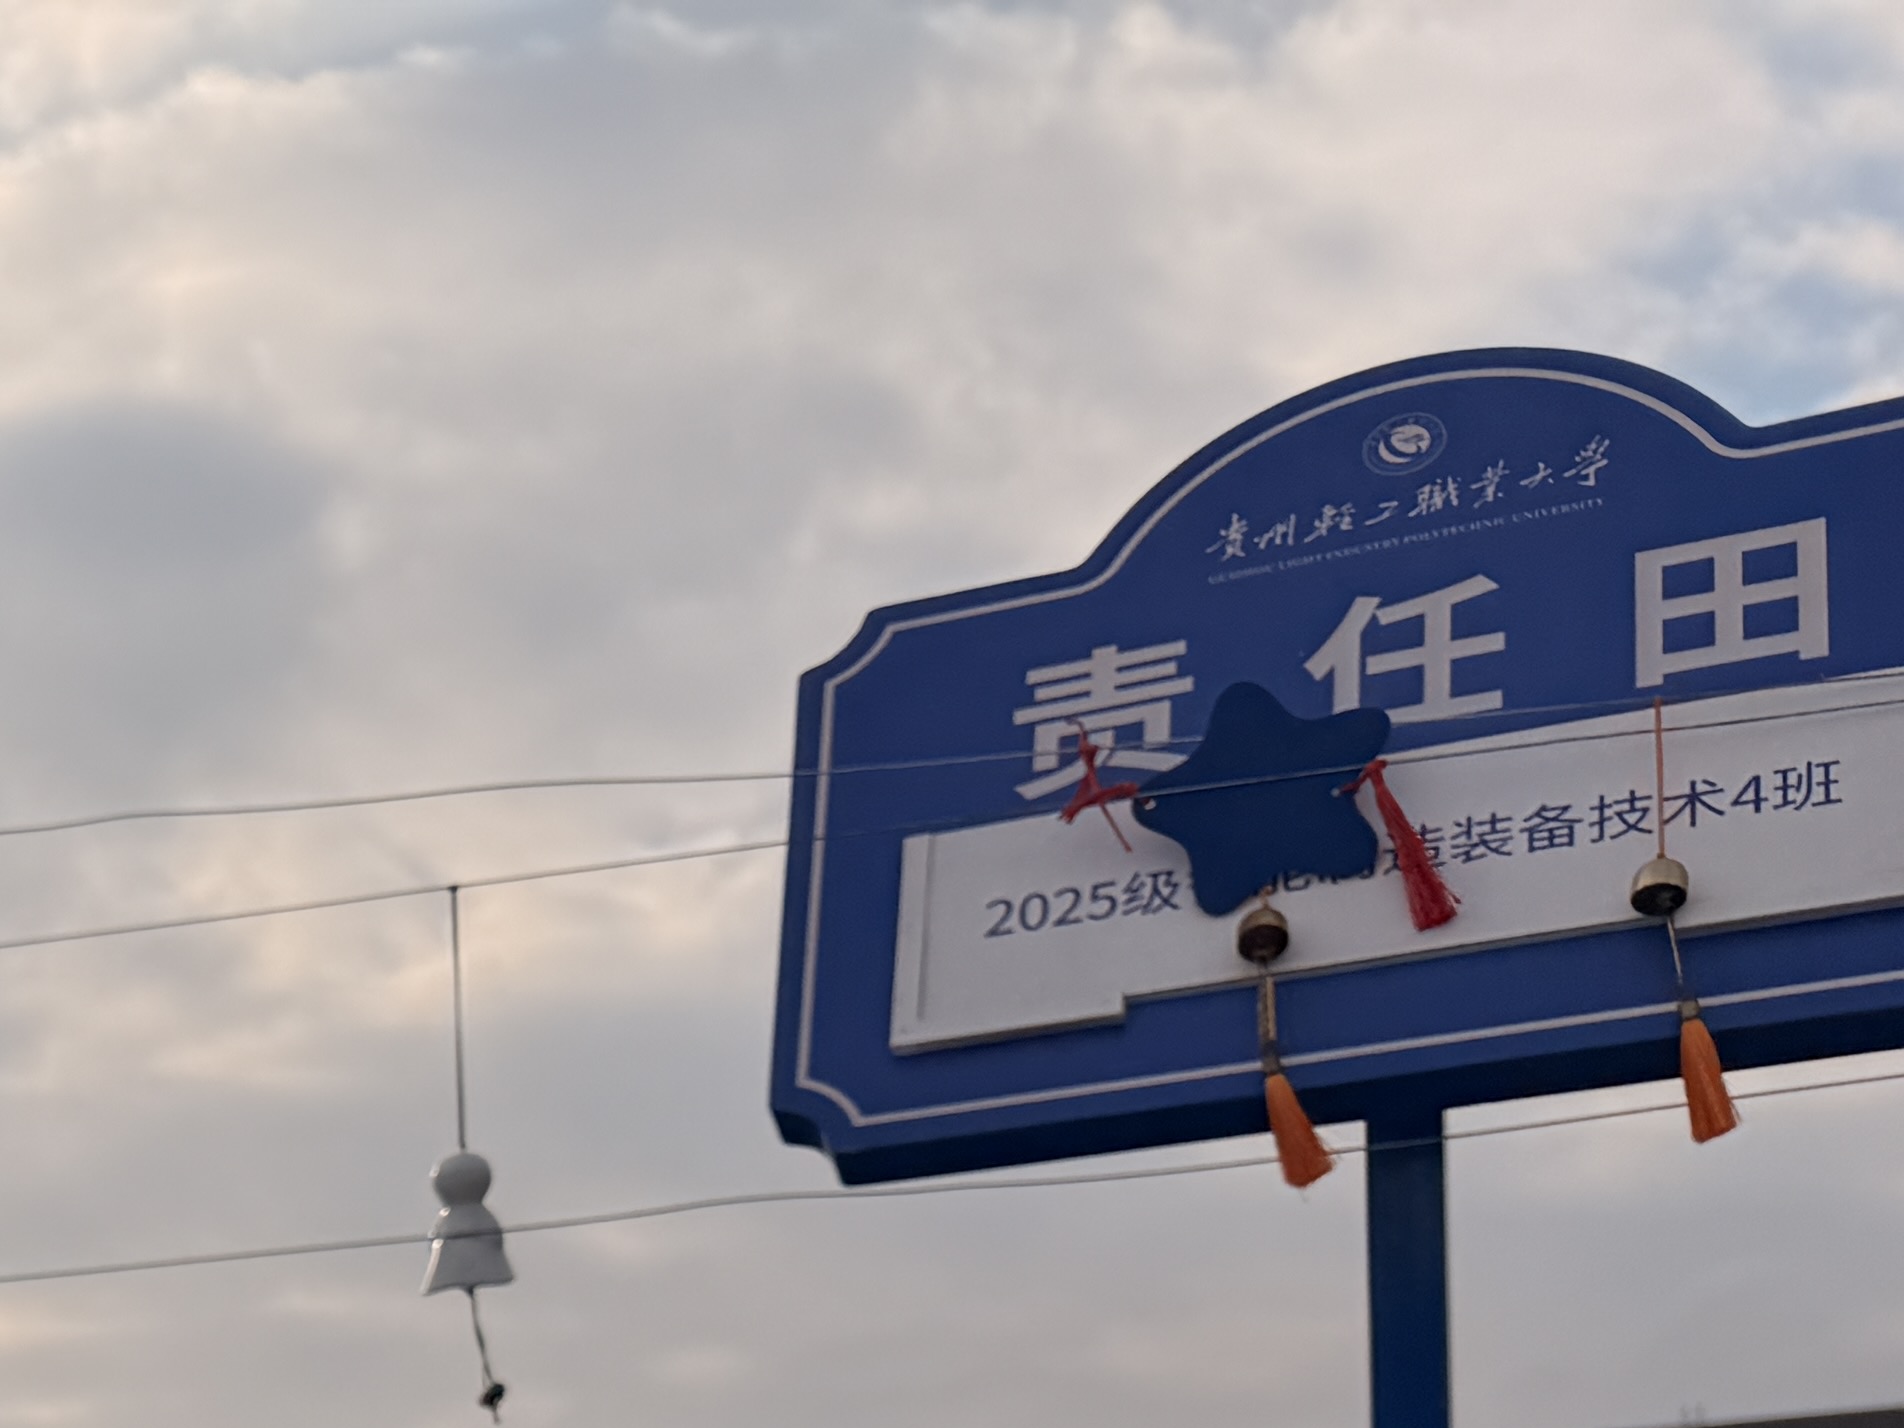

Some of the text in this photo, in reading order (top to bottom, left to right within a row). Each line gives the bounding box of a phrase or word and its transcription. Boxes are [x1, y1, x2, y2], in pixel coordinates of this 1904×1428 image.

[1403, 516, 1504, 545] POLYTECHNIC
[1512, 497, 1603, 523] UNIVERSITY
[1012, 517, 1829, 800] 责任田
